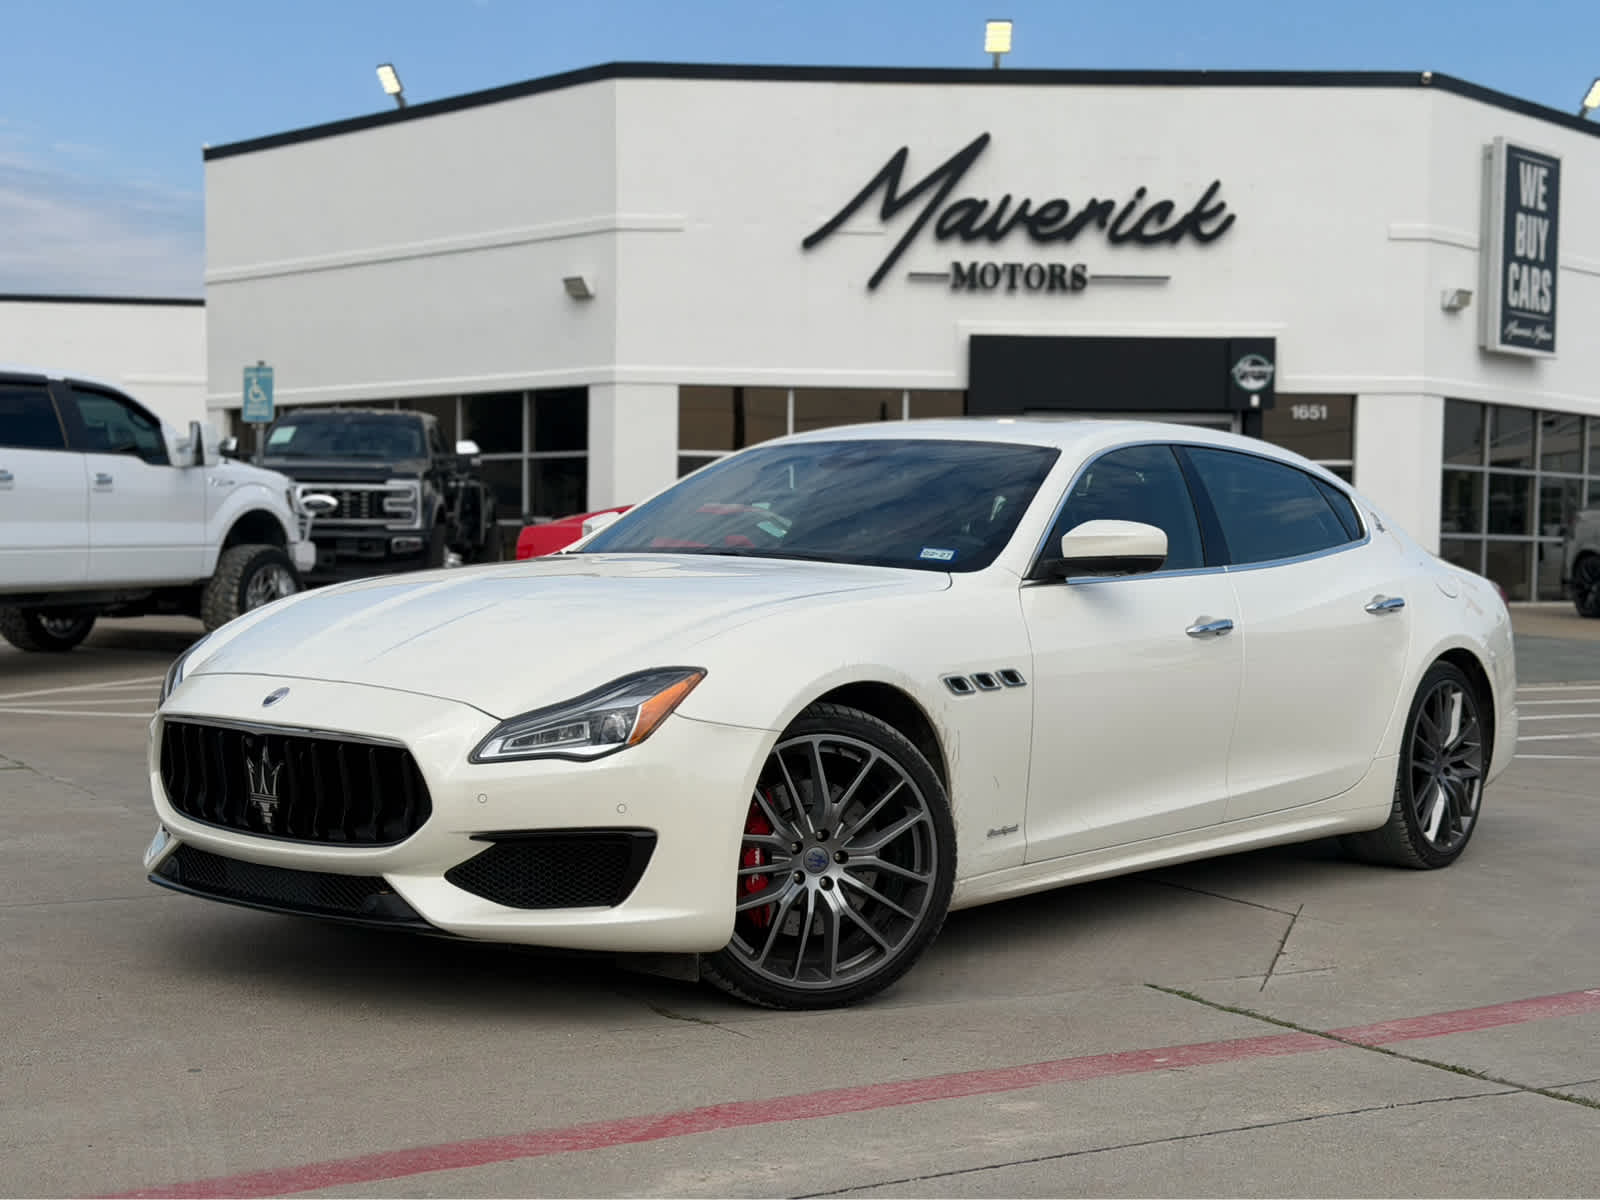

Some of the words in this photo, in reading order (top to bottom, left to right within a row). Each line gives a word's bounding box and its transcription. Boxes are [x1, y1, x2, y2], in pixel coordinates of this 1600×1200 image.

[1519, 162, 1548, 210] WE
[801, 131, 1237, 291] Maverick
[1515, 212, 1549, 261] BUY
[950, 262, 1089, 292] MOTORS
[1507, 262, 1552, 313] CARS
[1290, 405, 1328, 420] 1651
